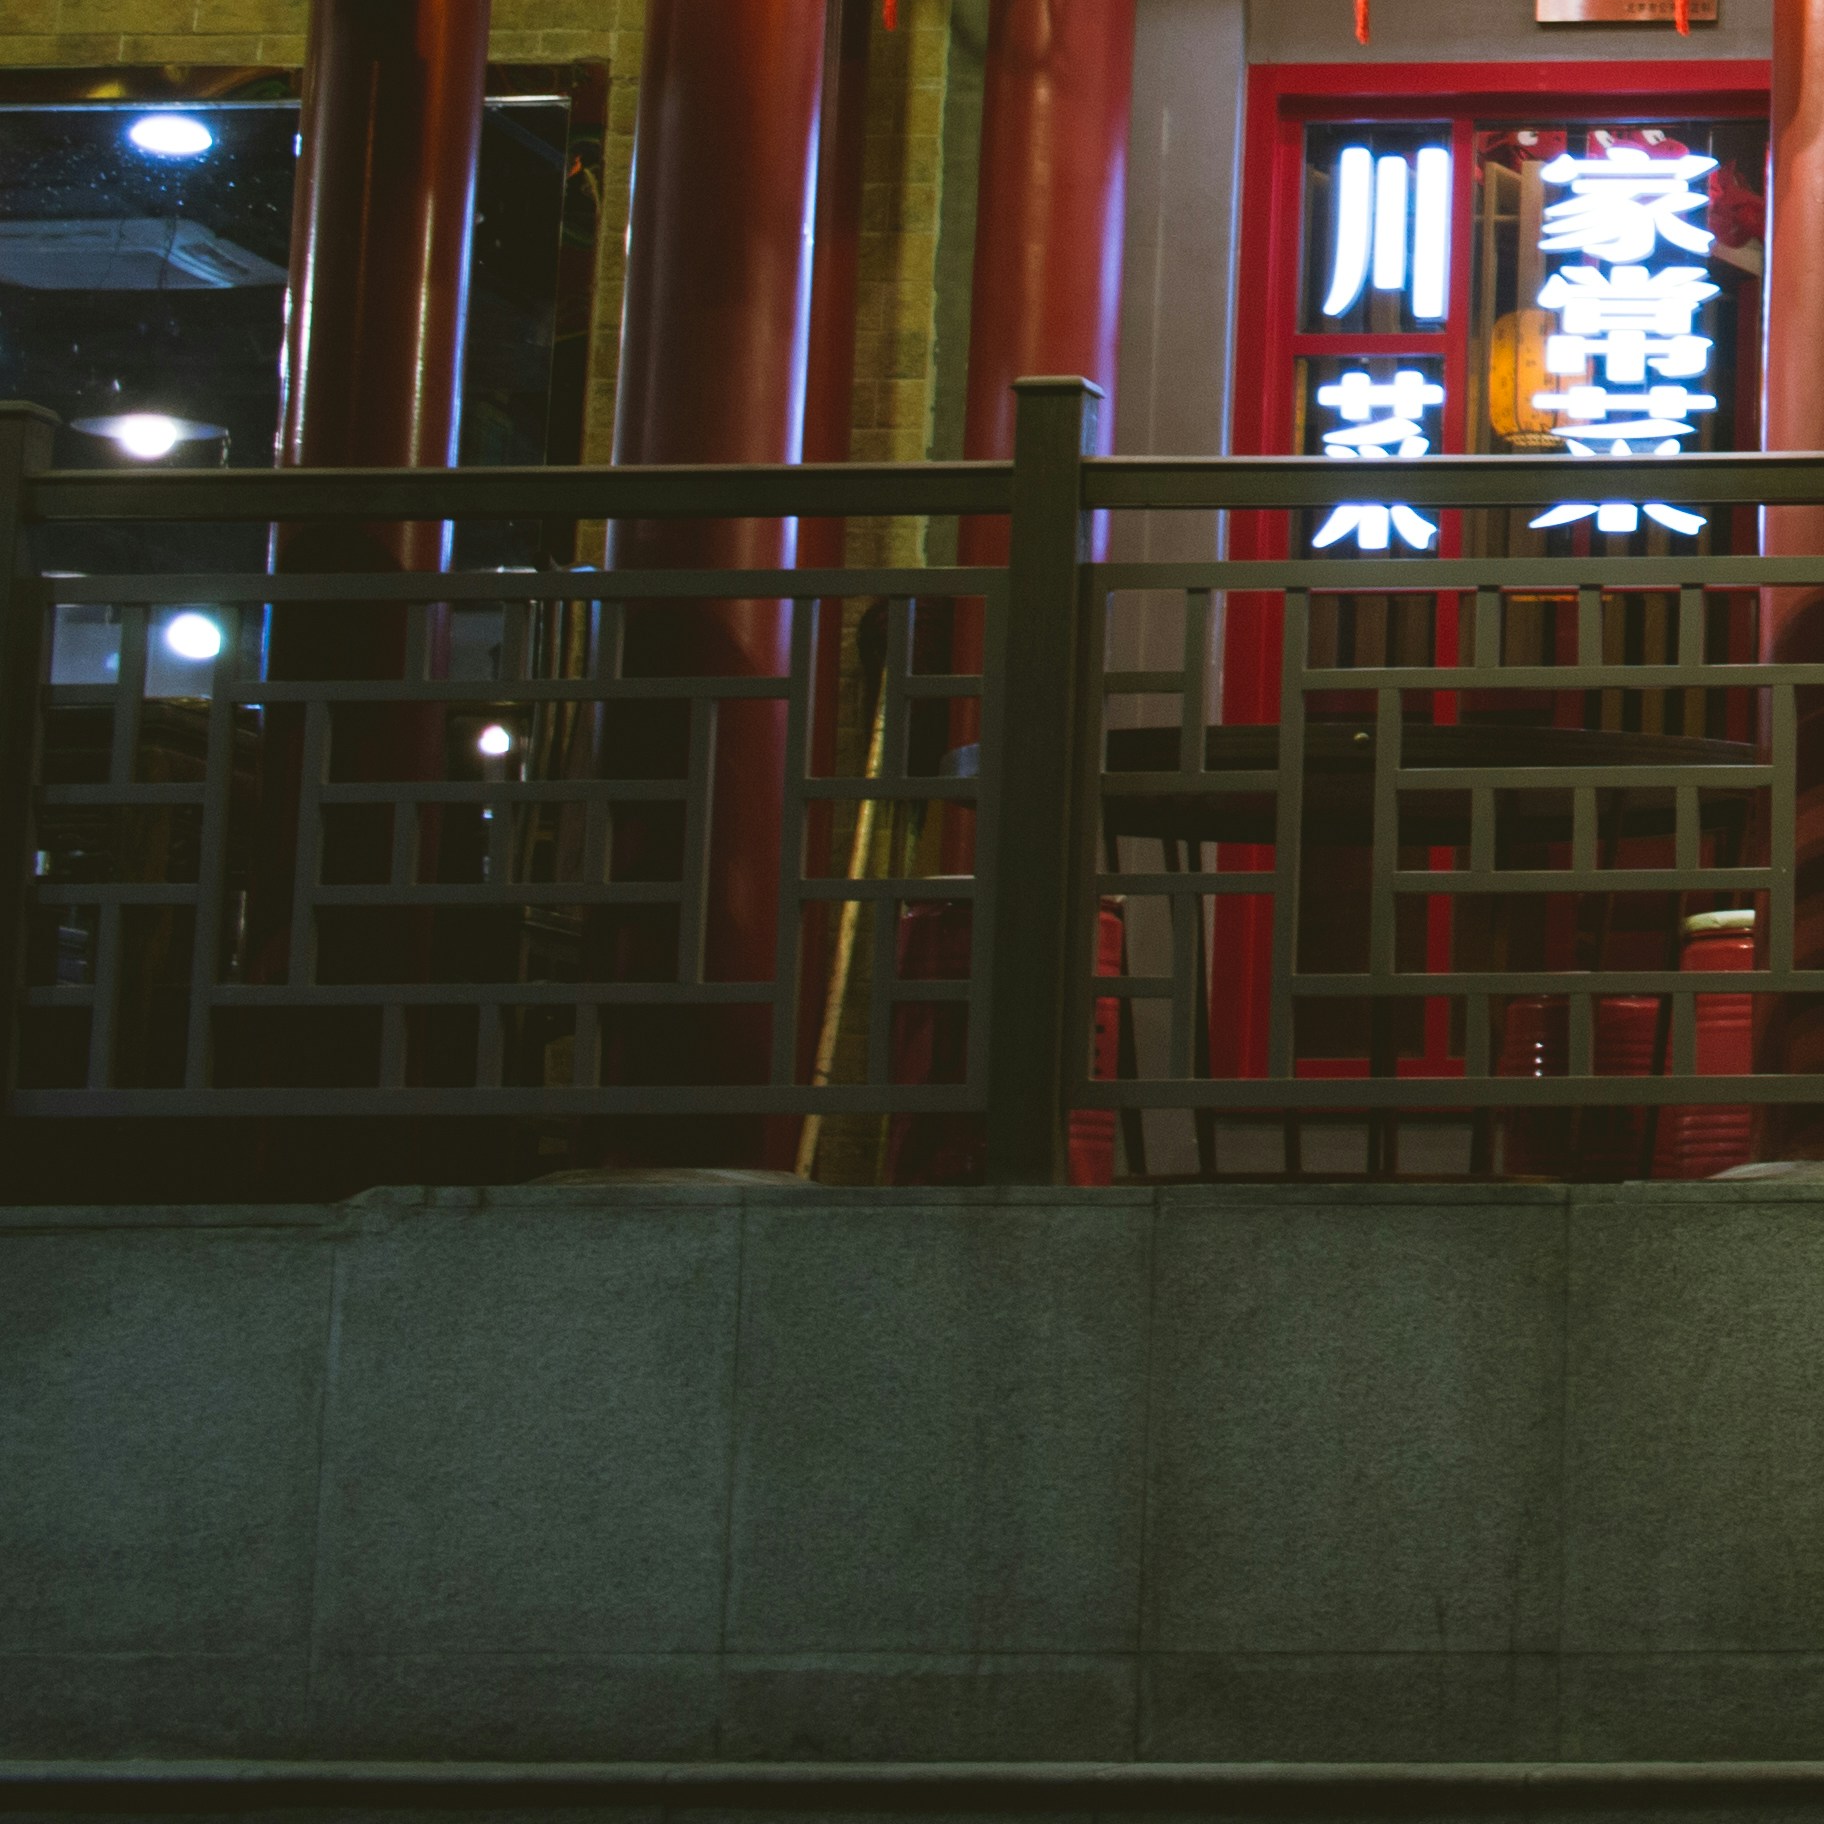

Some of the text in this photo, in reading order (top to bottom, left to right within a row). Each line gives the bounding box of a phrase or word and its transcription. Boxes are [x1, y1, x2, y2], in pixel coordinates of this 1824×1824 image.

[1312, 147, 1451, 550] 川菜
[1530, 149, 1721, 536] 家常菜
